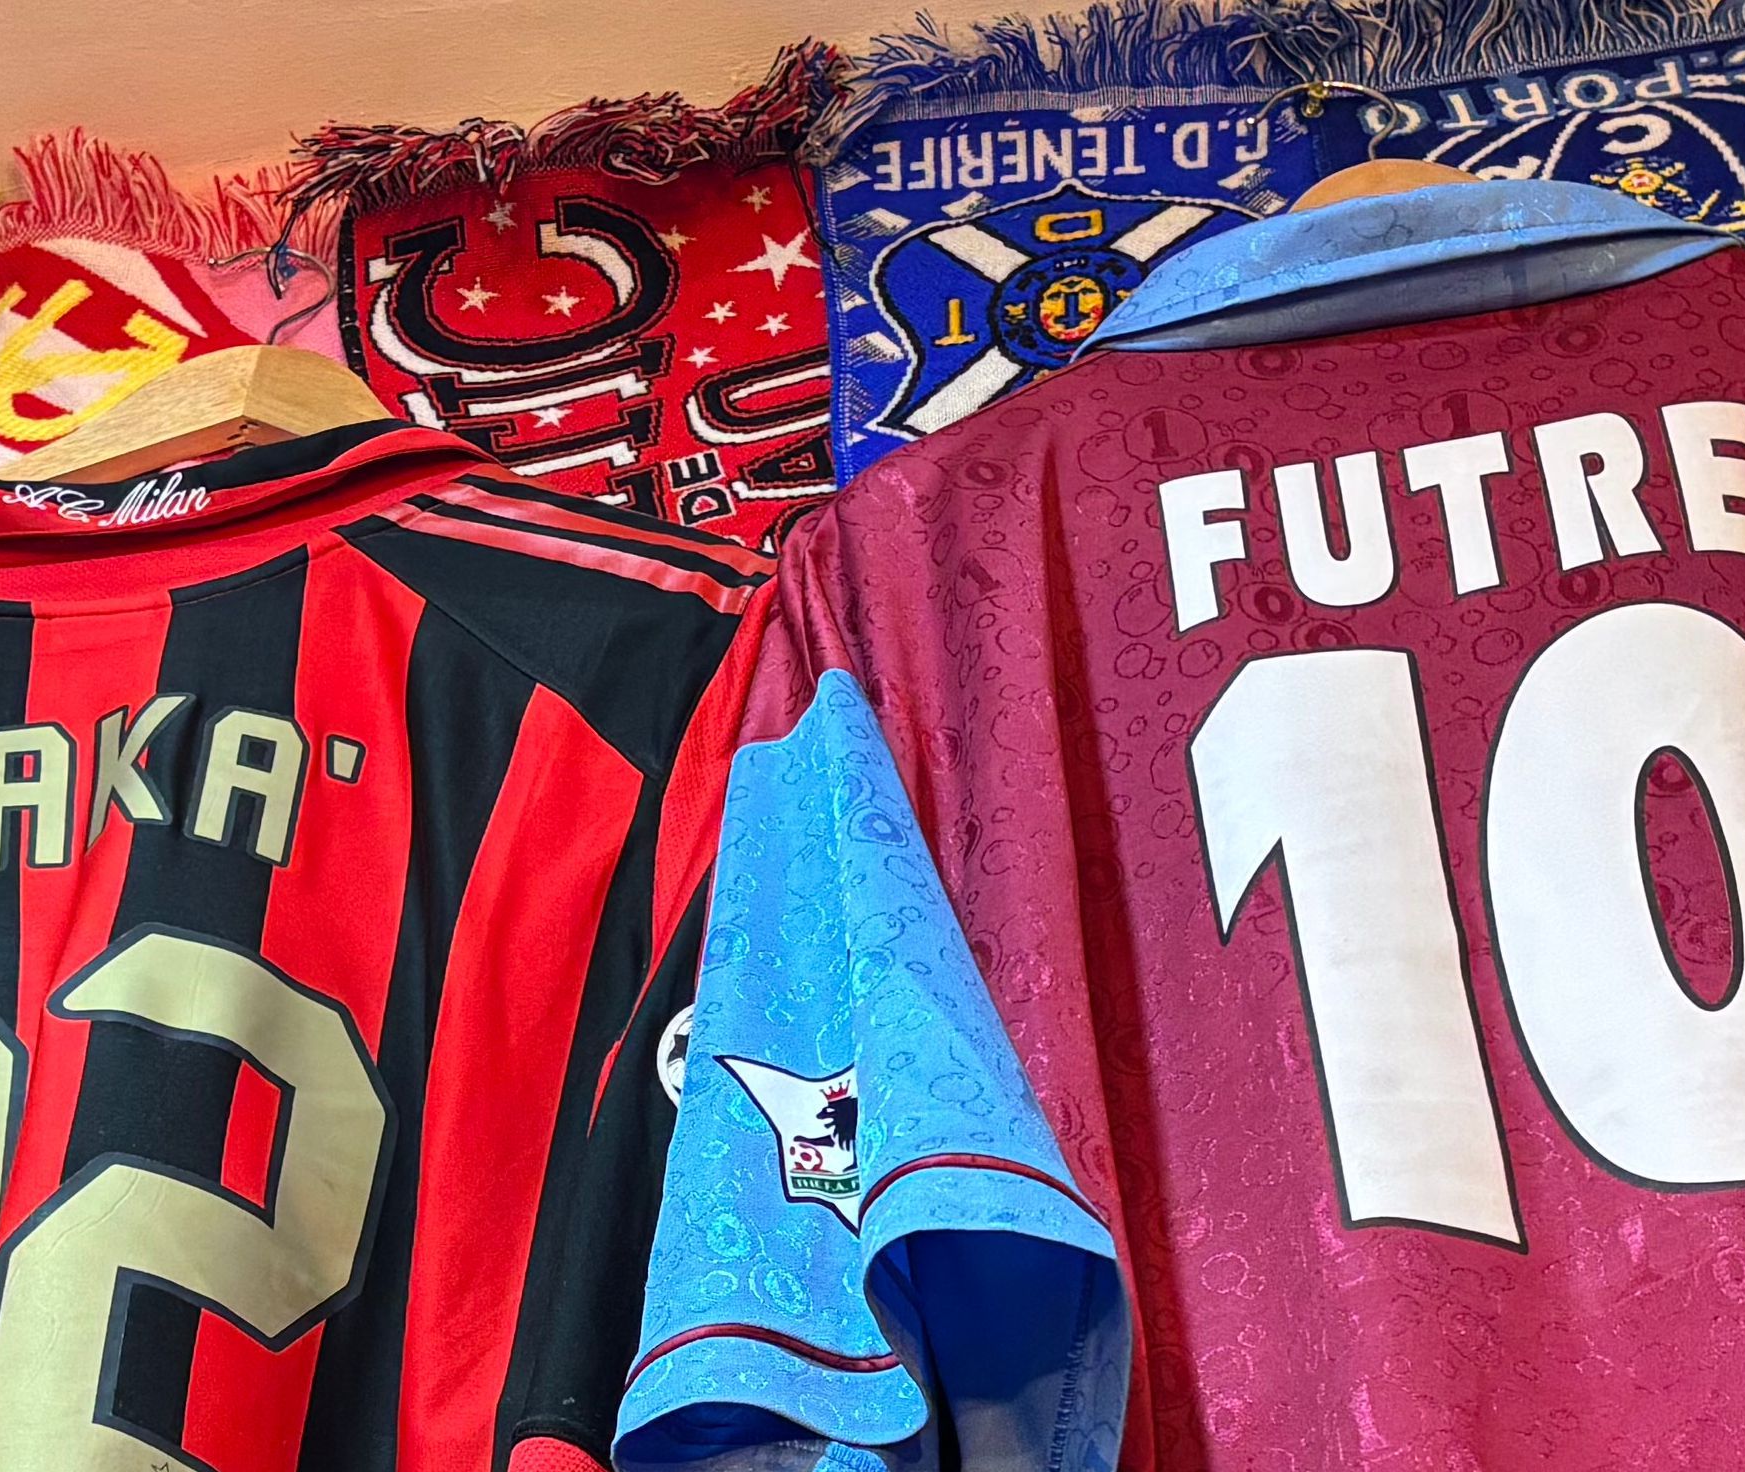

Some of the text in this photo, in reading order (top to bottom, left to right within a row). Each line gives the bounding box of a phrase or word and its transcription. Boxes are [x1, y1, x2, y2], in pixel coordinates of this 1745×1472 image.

[872, 119, 1146, 195] TENERIFE
[99, 468, 212, 528] Milan
[664, 451, 735, 528] DE
